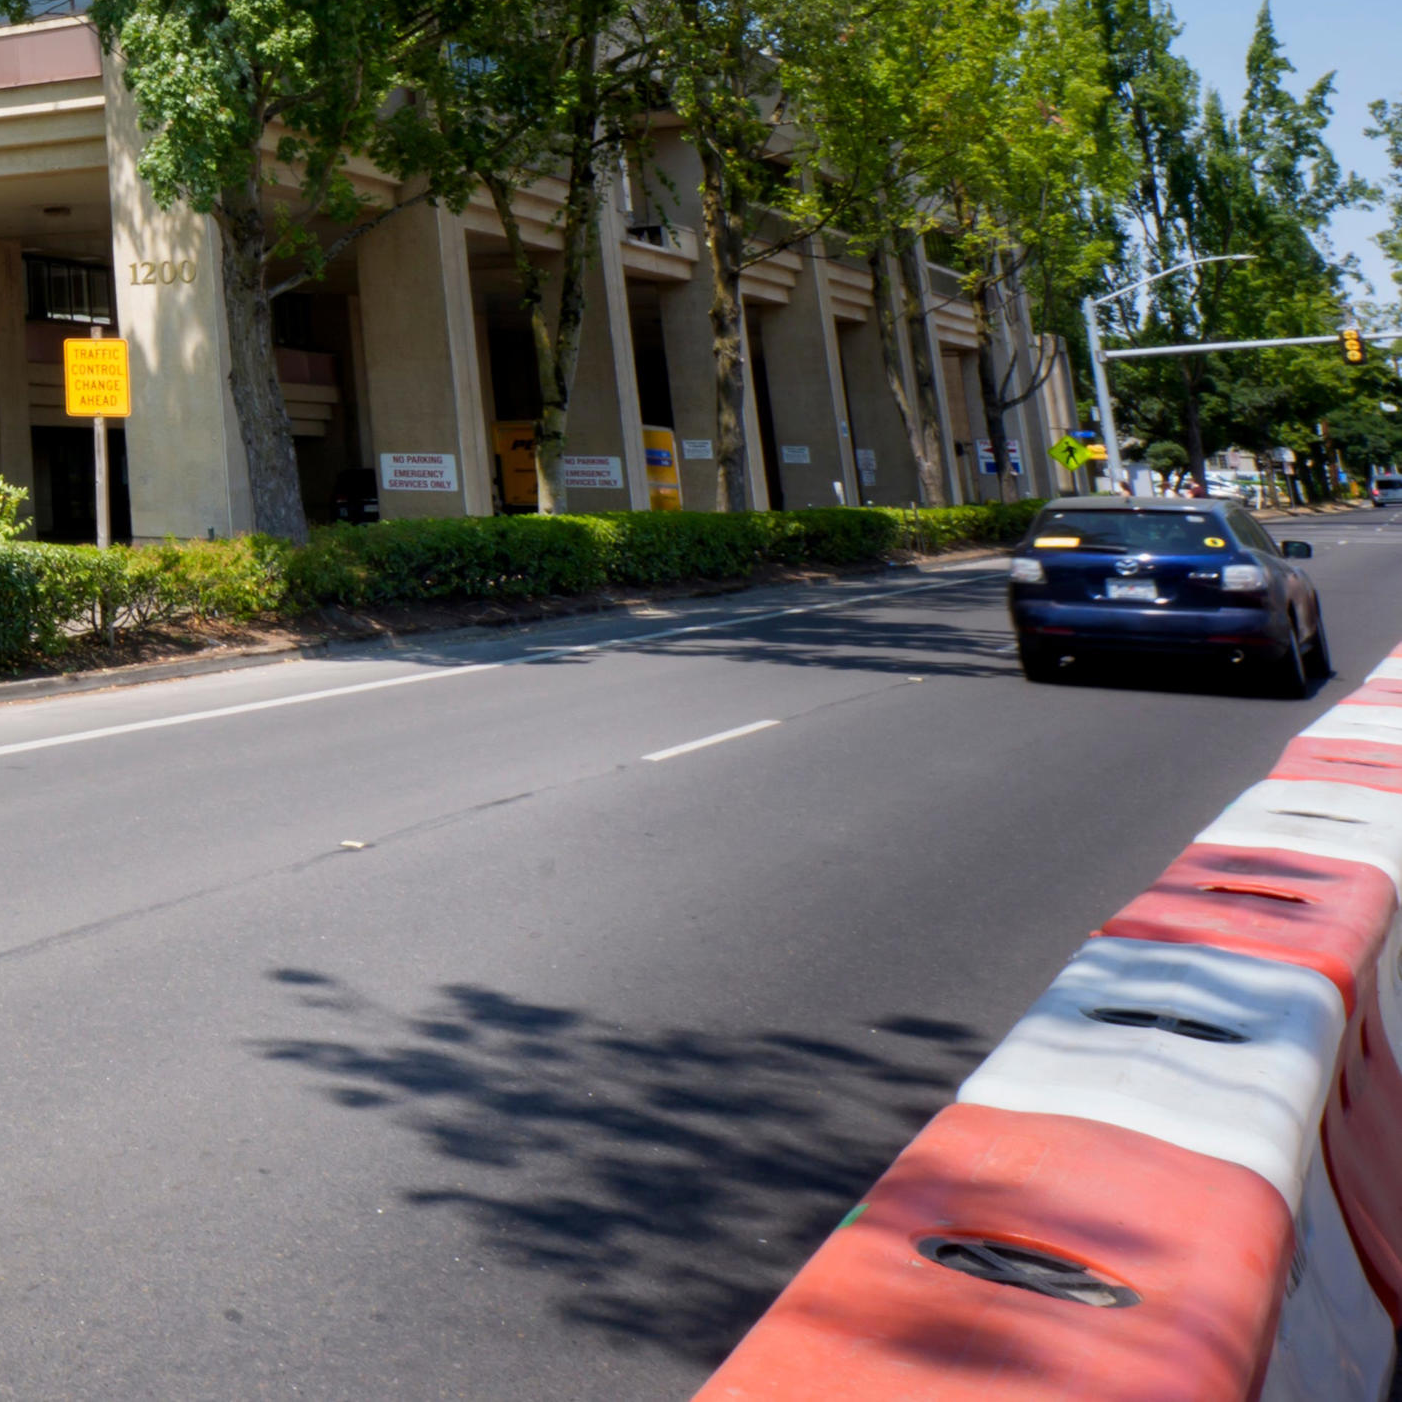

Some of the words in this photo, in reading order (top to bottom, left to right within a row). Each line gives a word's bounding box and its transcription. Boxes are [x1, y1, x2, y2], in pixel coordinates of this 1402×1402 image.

[128, 260, 196, 286] 1200
[74, 349, 120, 360] TRAFFIC
[71, 364, 124, 376] CONTROL
[75, 380, 121, 391] CHANGE
[79, 394, 117, 407] AHEAD
[392, 455, 405, 464] NO
[407, 455, 443, 464] PARKING
[577, 457, 610, 466] PARKING
[394, 469, 445, 479] EMERGENCY
[388, 479, 429, 489] SERVICES
[430, 480, 452, 489] ONLY
[598, 479, 618, 487] ONLY
